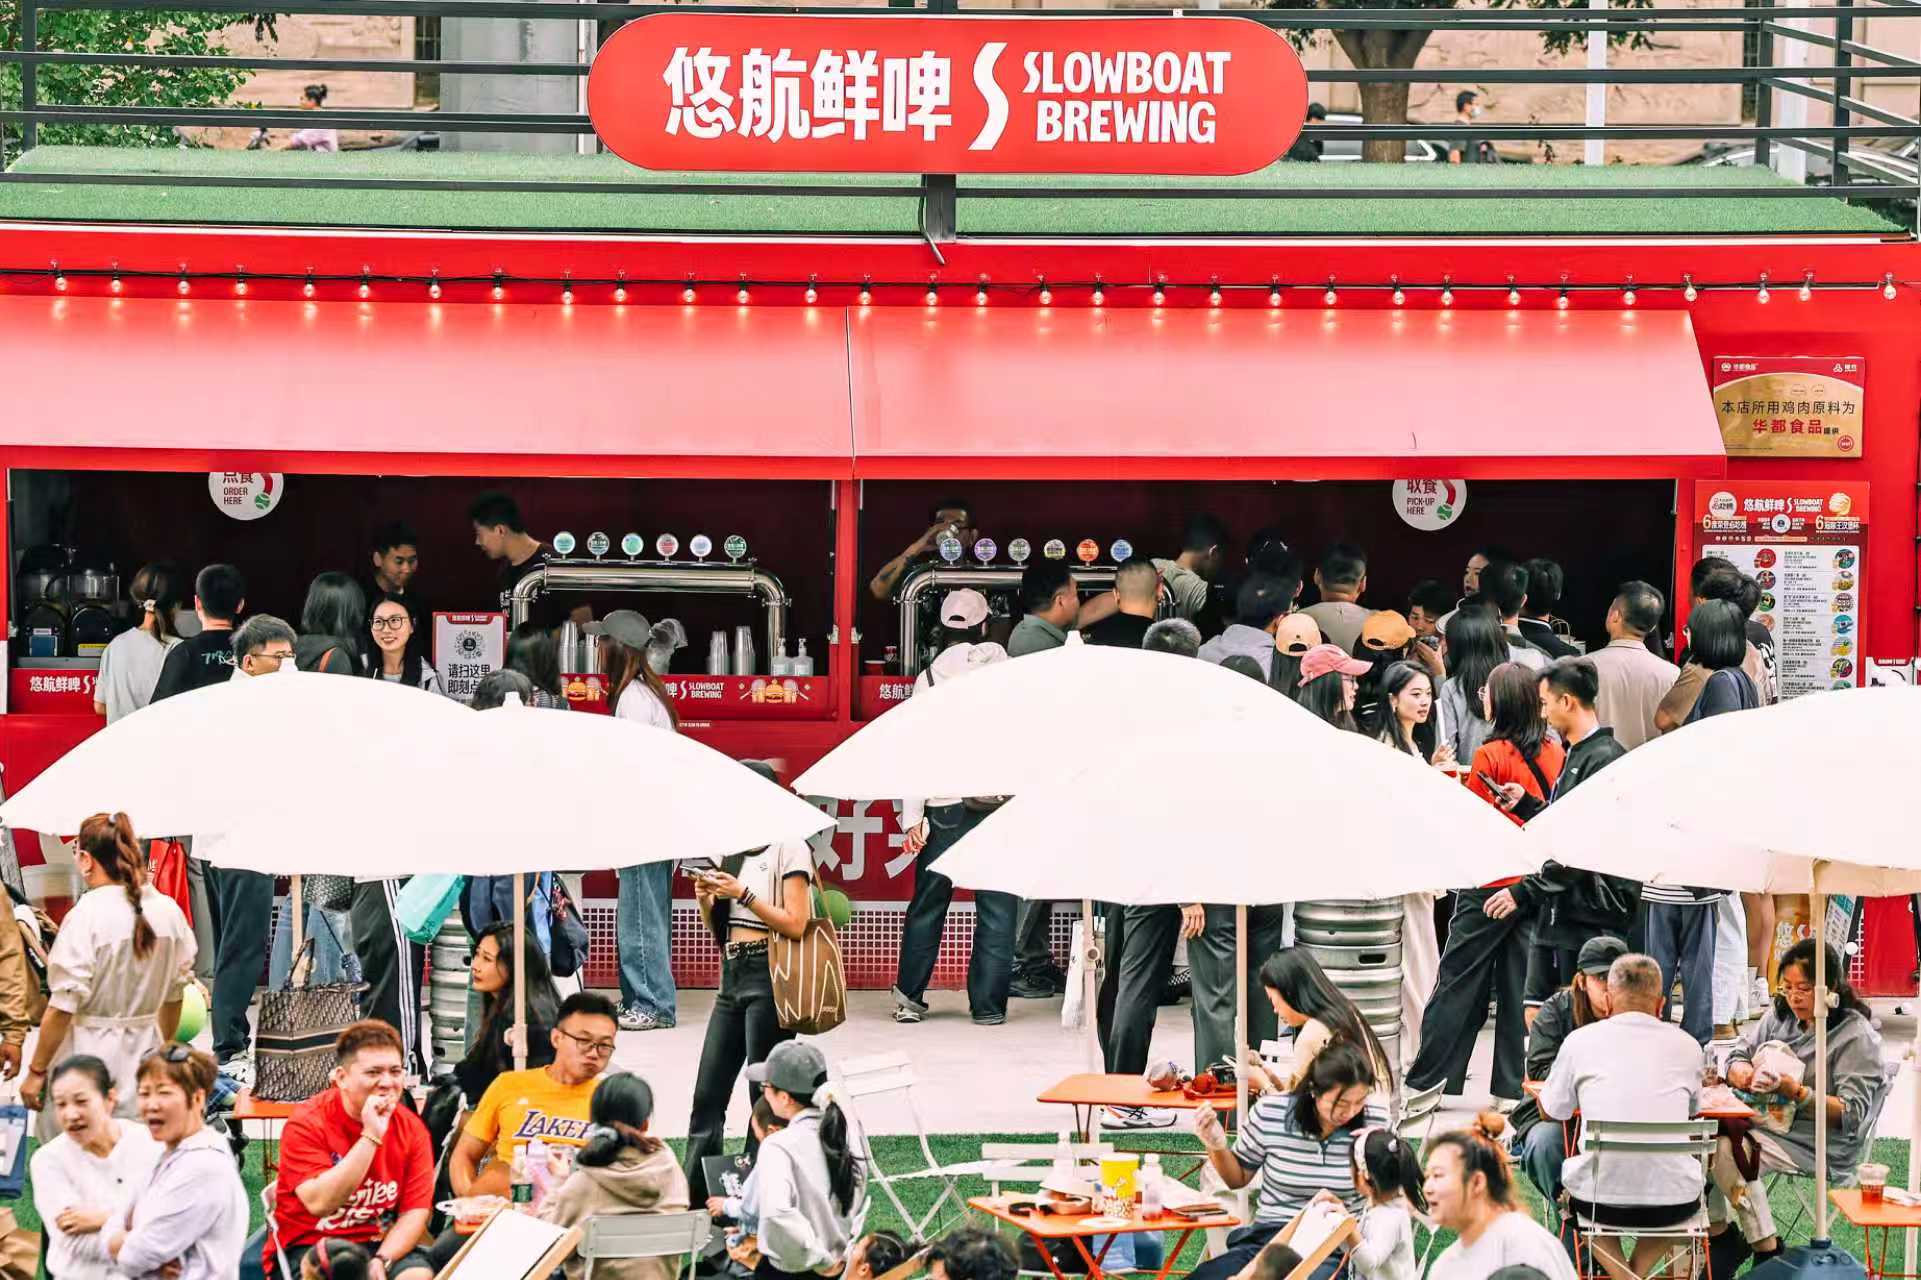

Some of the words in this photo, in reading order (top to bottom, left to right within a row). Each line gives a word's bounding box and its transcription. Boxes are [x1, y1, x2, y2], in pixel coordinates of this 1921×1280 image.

[1022, 51, 1232, 94] SLOWBOAT
[662, 47, 952, 143] 悠航鲜啤
[1036, 100, 1216, 143] BREWING
[1721, 400, 1855, 415] 本店所用鸡肉原料为
[1753, 419, 1822, 434] 华都食品
[223, 487, 248, 496] ORDER
[223, 496, 243, 504] HERE
[1407, 506, 1425, 515] HERE
[448, 664, 491, 678] 请扫这里
[30, 676, 81, 692] 悠航鲜啤
[689, 682, 724, 690] SLOWBOAT
[691, 690, 722, 699] BREWING
